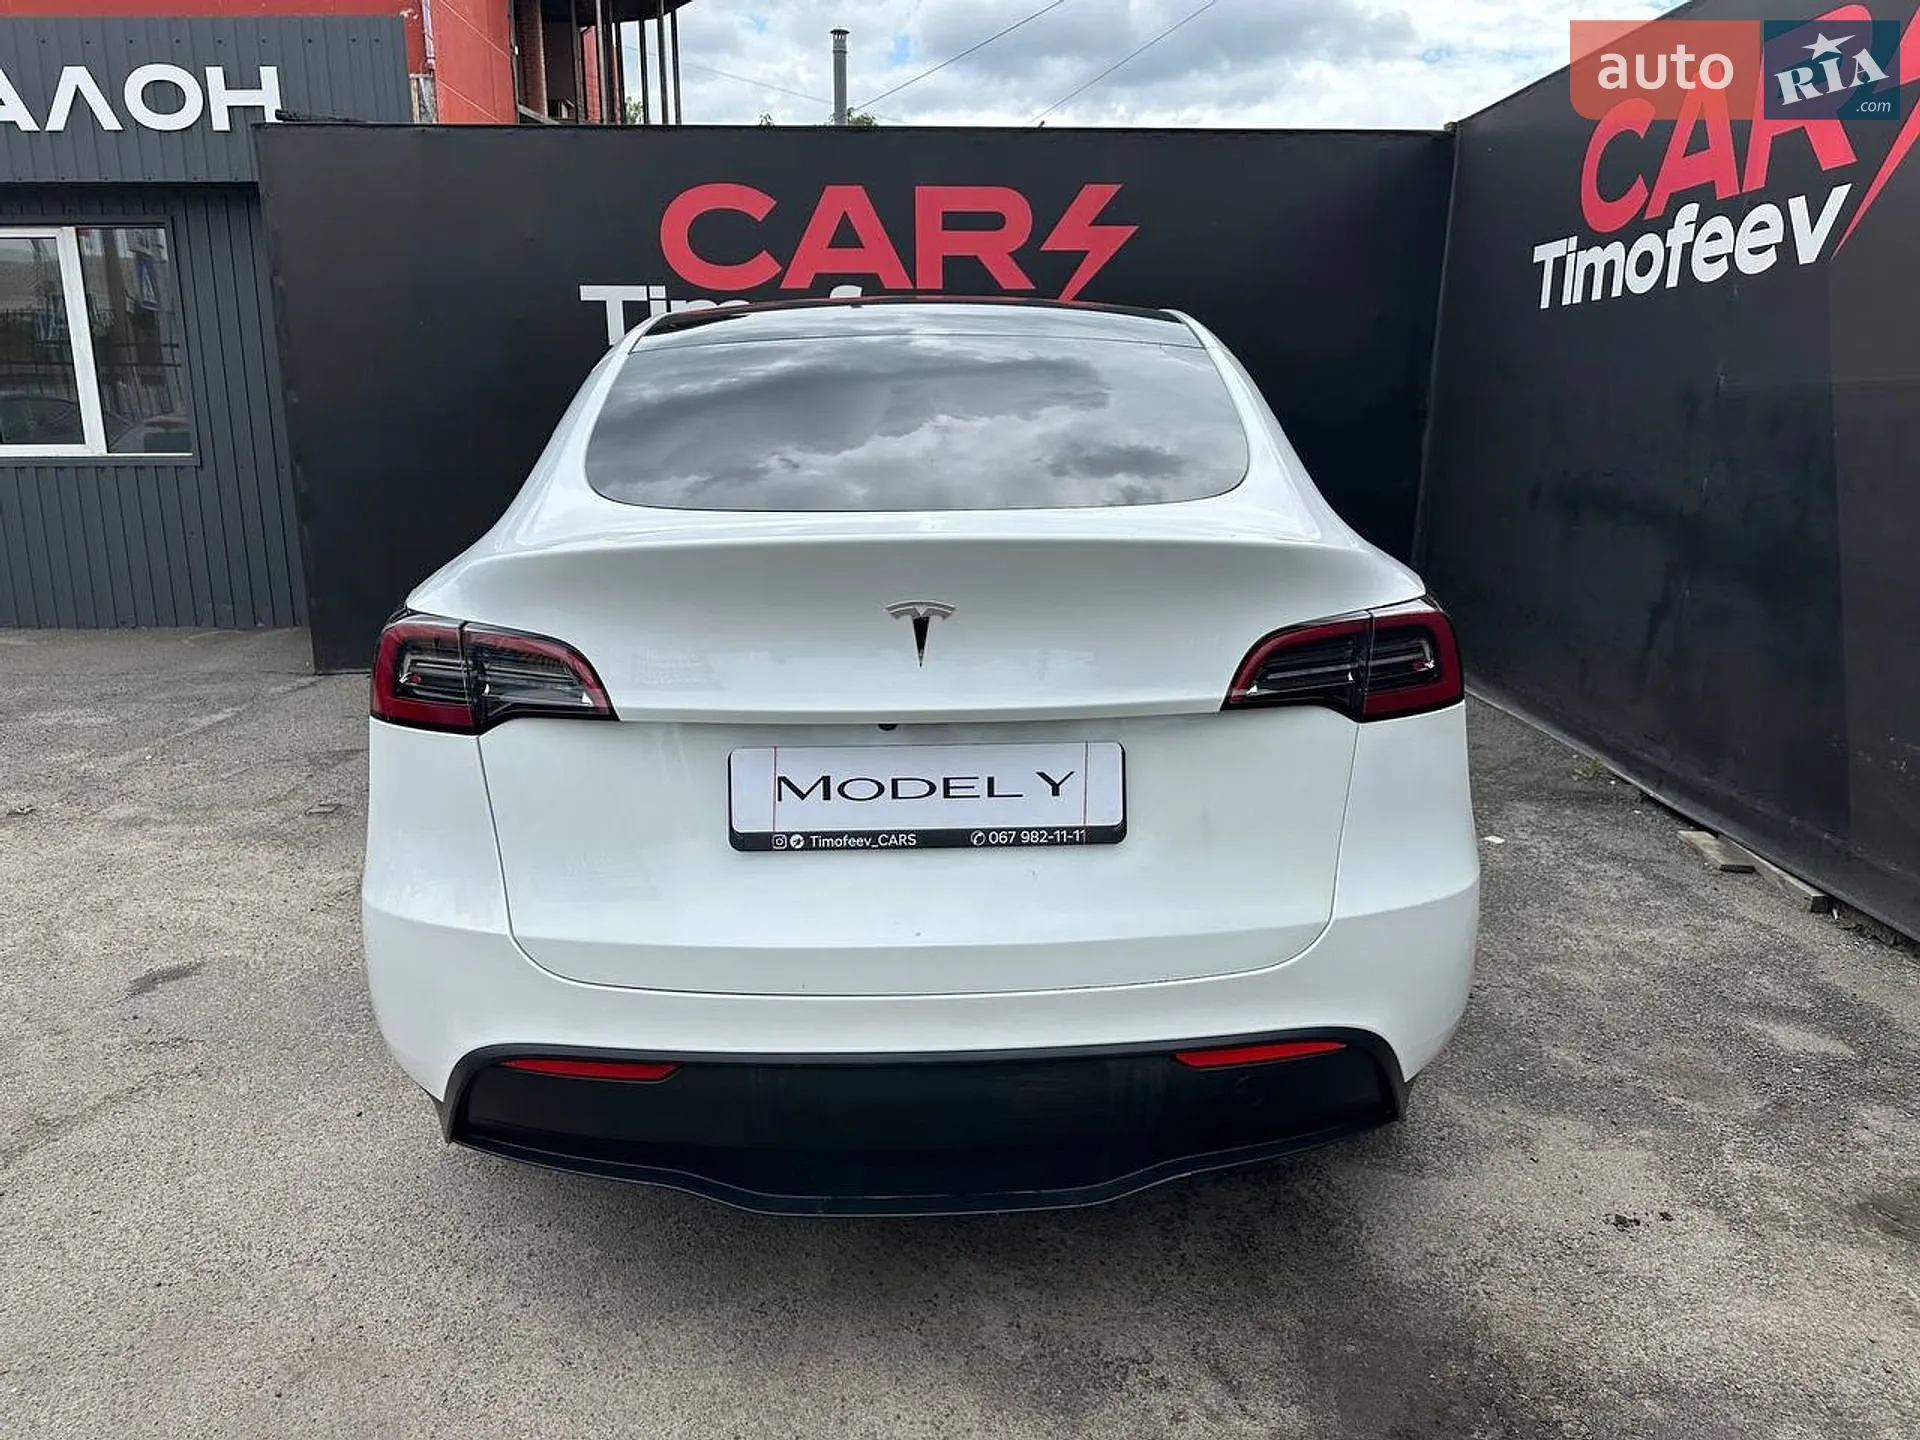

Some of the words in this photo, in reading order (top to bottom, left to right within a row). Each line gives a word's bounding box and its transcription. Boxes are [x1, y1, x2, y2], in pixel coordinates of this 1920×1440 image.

[1533, 183, 1852, 309] Timofeev
[776, 774, 1024, 802] MODEL
[1035, 770, 1075, 797] Y
[809, 833, 917, 848] Timofeev_CARS
[988, 830, 1017, 844] 067
[1020, 829, 1086, 844] 982-11-11
